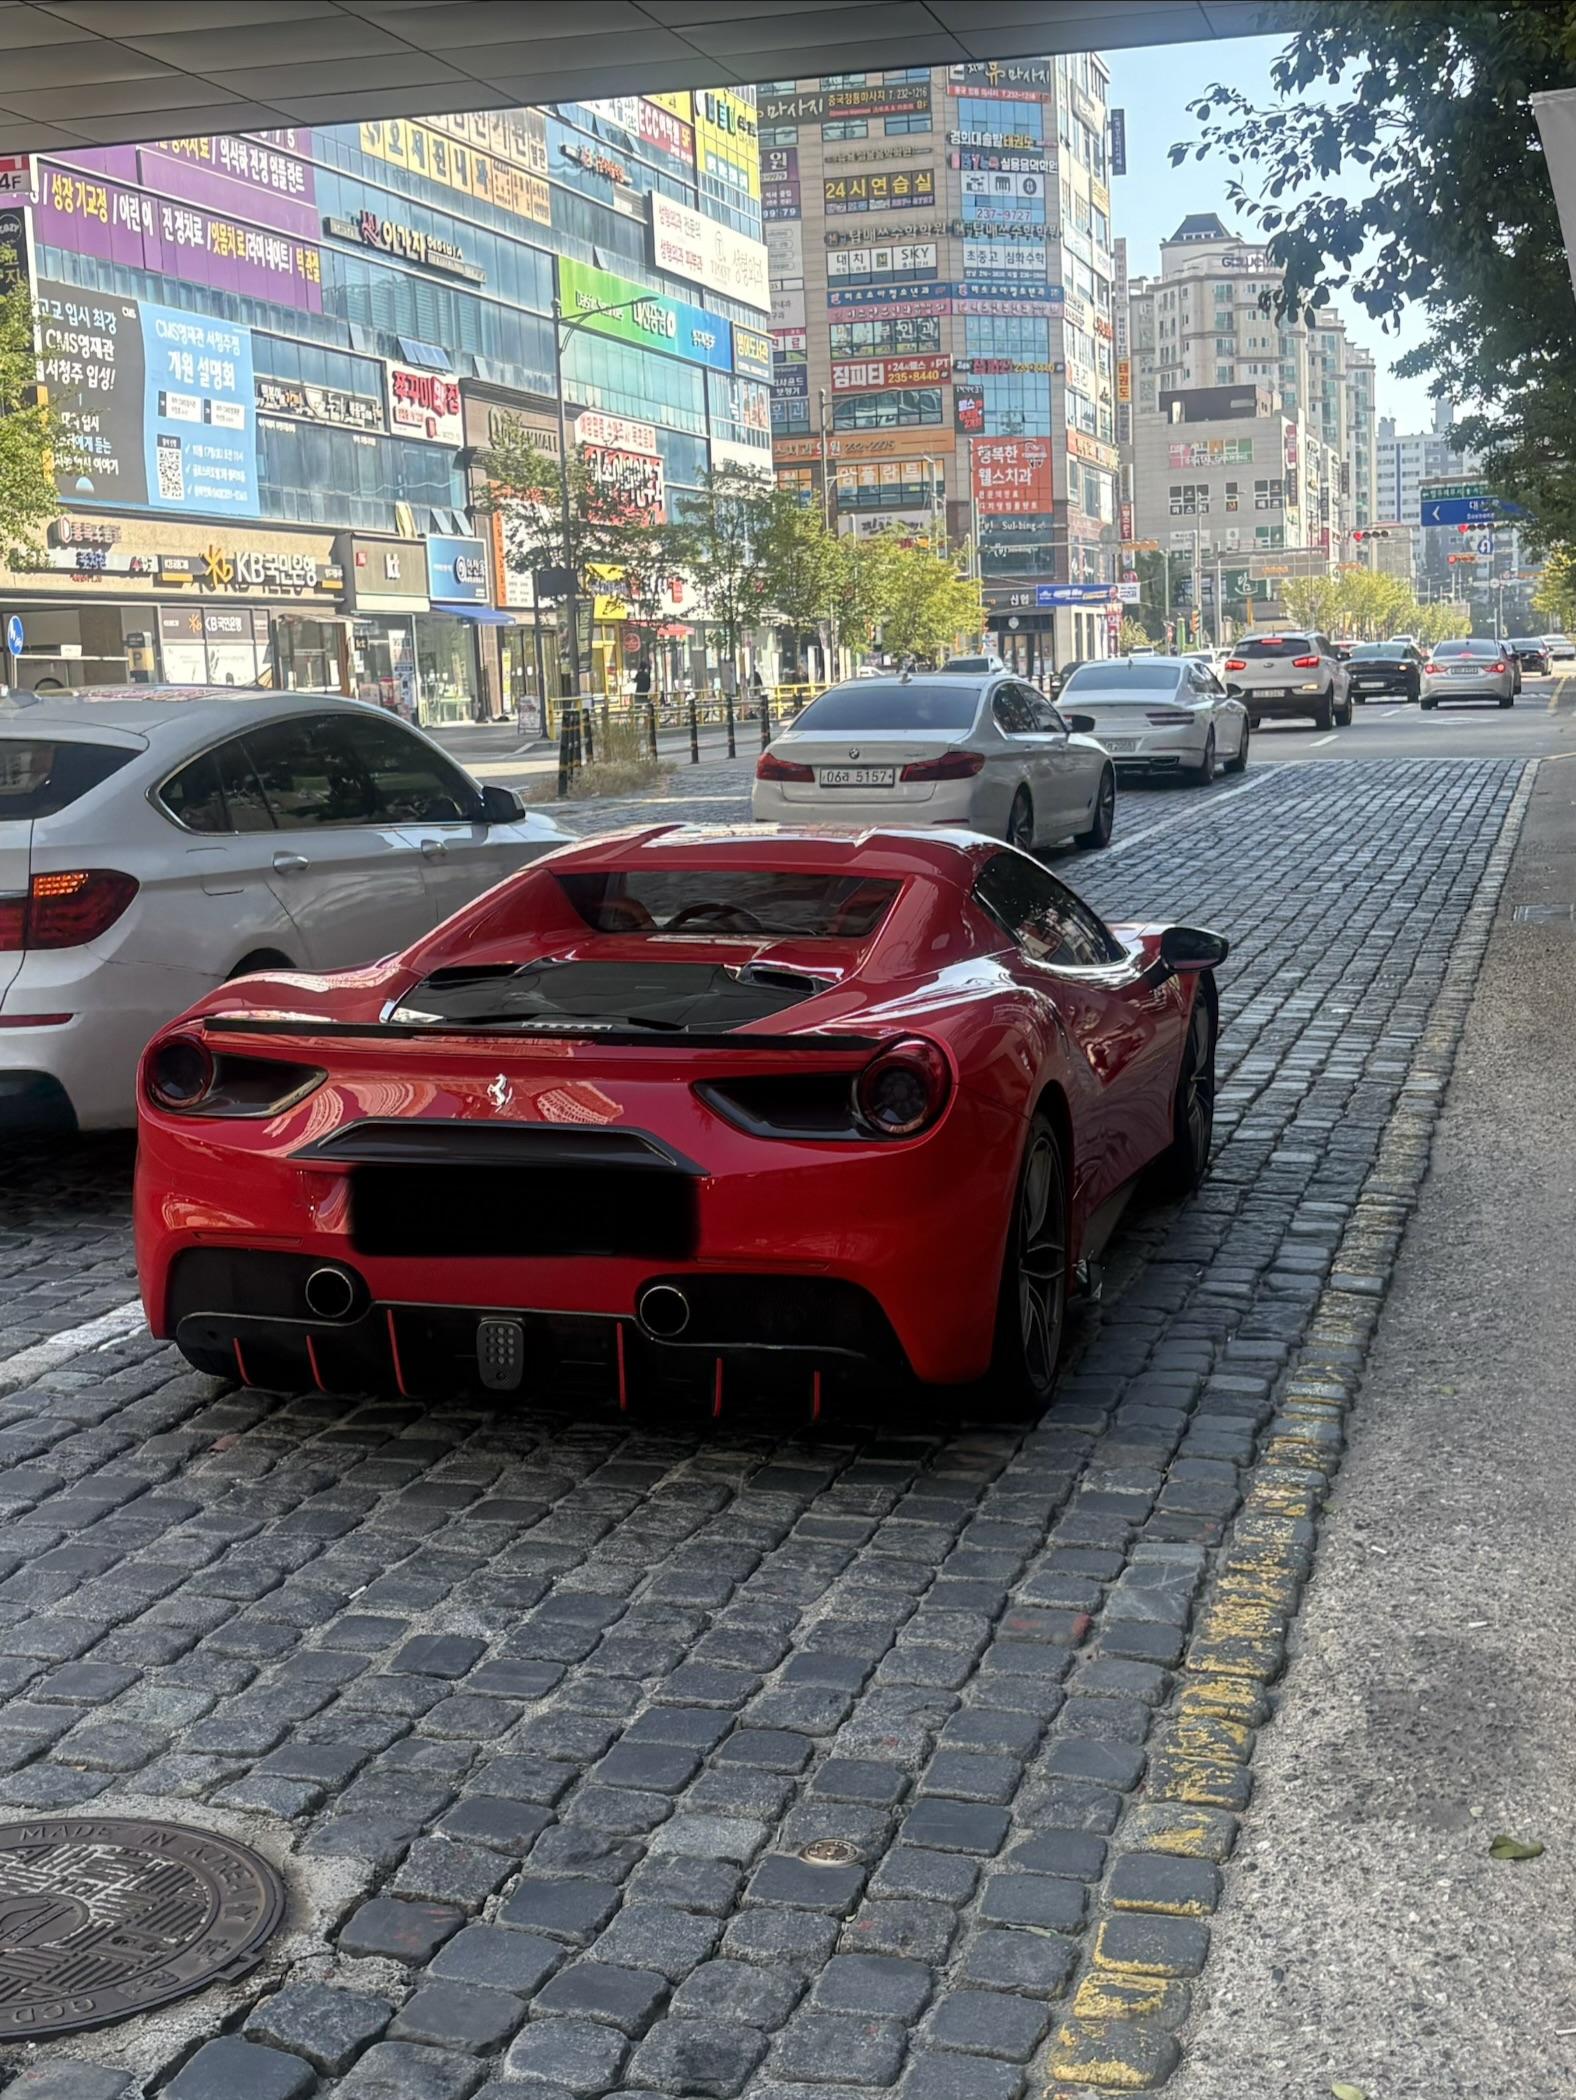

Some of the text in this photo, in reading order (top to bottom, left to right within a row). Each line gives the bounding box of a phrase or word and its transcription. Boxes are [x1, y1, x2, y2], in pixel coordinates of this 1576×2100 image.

[767, 97, 823, 120] 마사지
[976, 208, 1031, 221] 237-9727
[901, 247, 929, 260] SKY
[966, 249, 1045, 265] 초중고 심화수학
[45, 359, 84, 385] 서청주
[977, 444, 1018, 464] 행복한
[234, 551, 318, 588] KB국민은행
[855, 770, 887, 783] 5157
[19, 1823, 259, 1922] MADE IN KOREA
